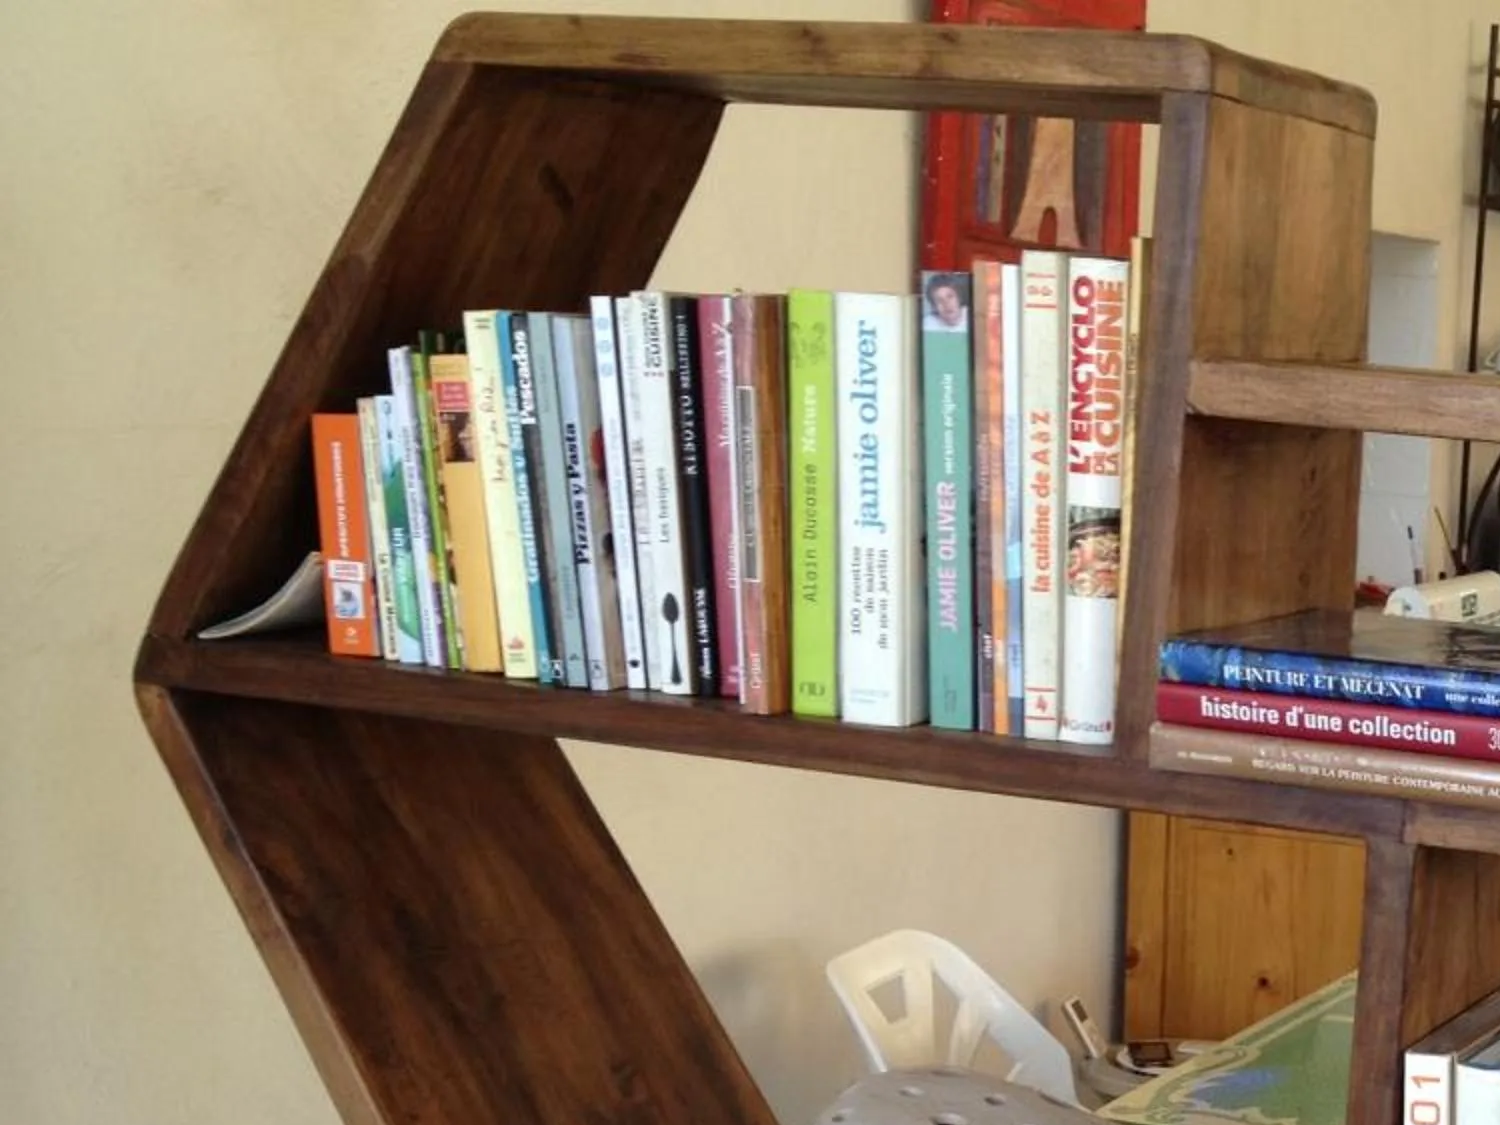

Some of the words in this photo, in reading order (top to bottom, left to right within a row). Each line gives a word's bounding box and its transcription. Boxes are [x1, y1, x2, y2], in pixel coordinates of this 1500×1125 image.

[512, 329, 536, 425] Pescados
[849, 319, 880, 426] oliver
[1069, 275, 1095, 476] L'ENCYCLO
[1094, 280, 1124, 447] CUISINE
[565, 422, 581, 480] Pasta
[681, 395, 698, 475] RISOTTO
[802, 384, 818, 454] Nature
[1030, 410, 1050, 427] Z
[853, 431, 887, 534] jamie
[1030, 471, 1051, 499] de
[1031, 446, 1051, 465] A
[573, 501, 591, 565] Pizzas
[803, 462, 819, 541] Ducasse
[936, 480, 957, 560] OLIVER
[1029, 506, 1051, 572] cuisine
[804, 547, 819, 603] Alain
[939, 566, 958, 633] JAMIE
[1030, 575, 1050, 594] la
[1223, 665, 1311, 689] PEINTURE
[1313, 672, 1337, 691] ET
[1445, 690, 1469, 702] une
[1200, 695, 1280, 726] histoire
[1285, 705, 1343, 732] d'une
[1347, 715, 1456, 746] collection
[1321, 768, 1335, 778] LA
[1392, 774, 1484, 798] CONTEMPORAINE
